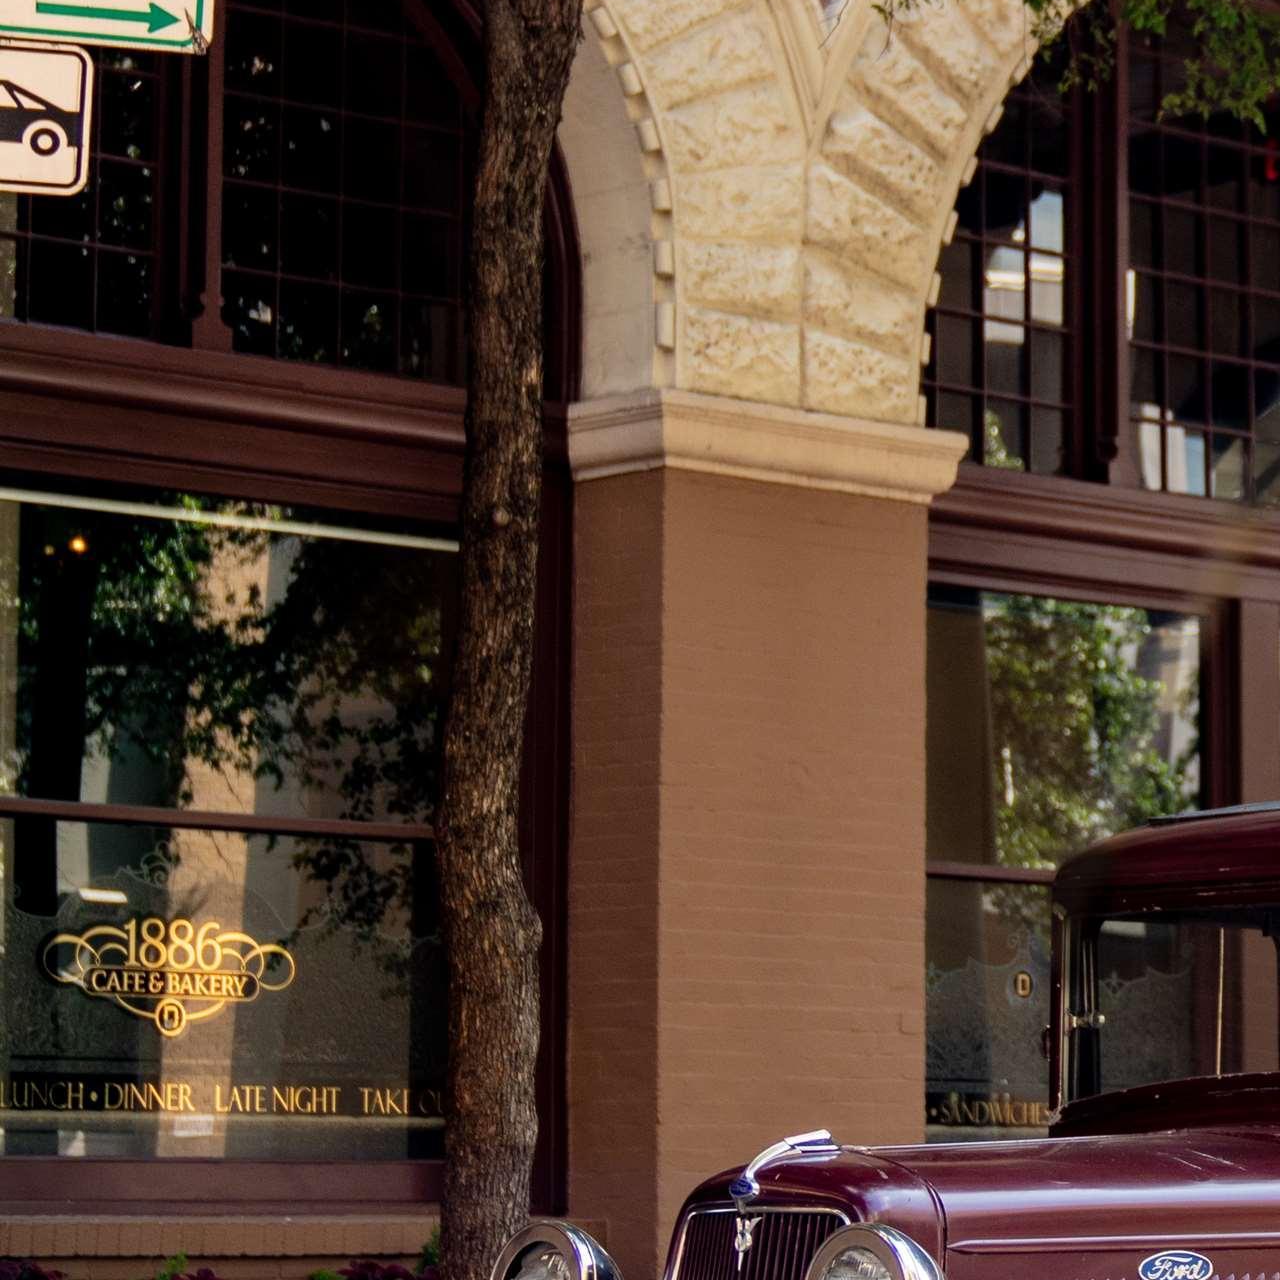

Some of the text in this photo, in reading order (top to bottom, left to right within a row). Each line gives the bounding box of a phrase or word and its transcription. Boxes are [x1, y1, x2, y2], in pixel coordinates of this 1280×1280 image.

[124, 918, 223, 971] 1886
[91, 970, 249, 997] CAFE & BAKERY
[1, 1081, 84, 1110] LUNCH
[104, 1082, 195, 1111] DINNER
[215, 1084, 267, 1112] LATE
[272, 1085, 341, 1114] NIGHT
[1147, 1255, 1206, 1280] Ford
